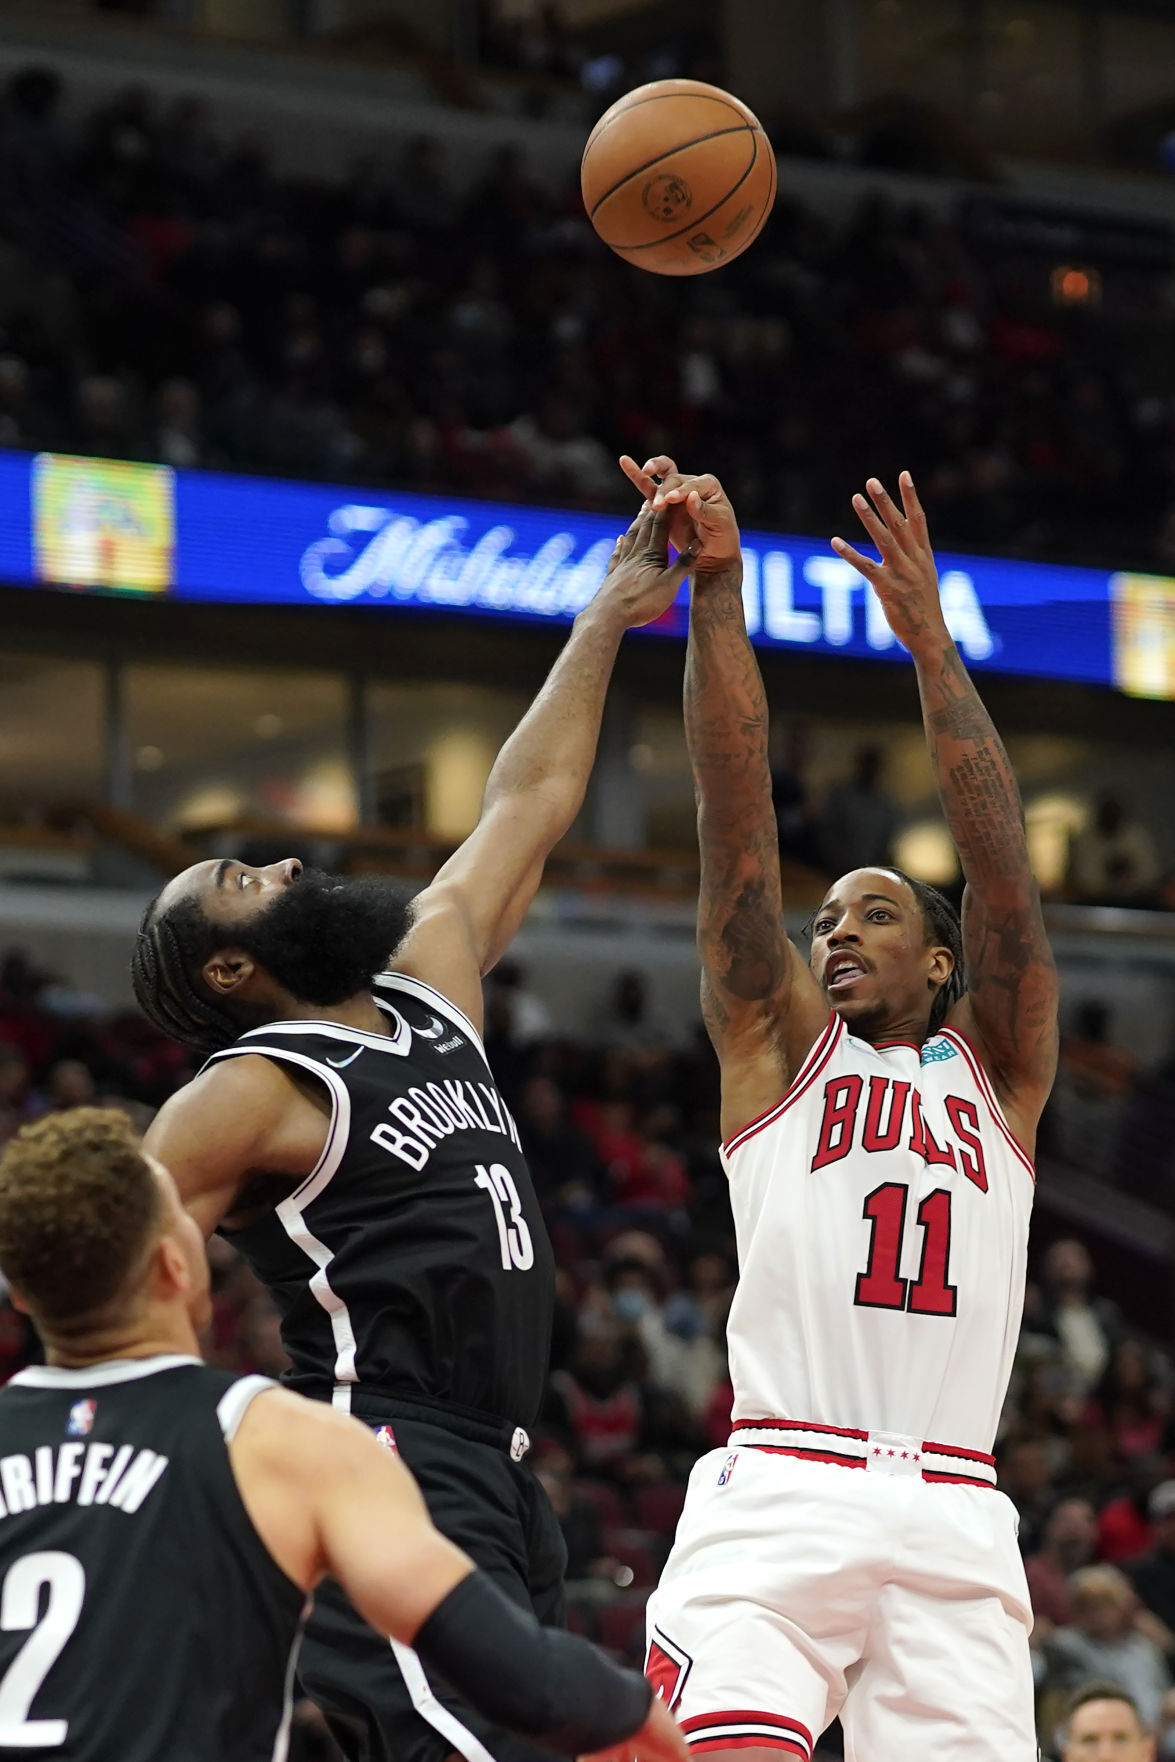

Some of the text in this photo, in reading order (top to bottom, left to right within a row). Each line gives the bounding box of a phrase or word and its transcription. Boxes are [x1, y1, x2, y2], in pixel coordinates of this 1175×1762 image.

[369, 1079, 523, 1172] BROOKLYN
[810, 1074, 989, 1194] BULLS
[473, 1163, 535, 1271] 13
[853, 1181, 958, 1318] 11
[0, 1442, 169, 1518] RIFFIN
[0, 1550, 86, 1748] 2
